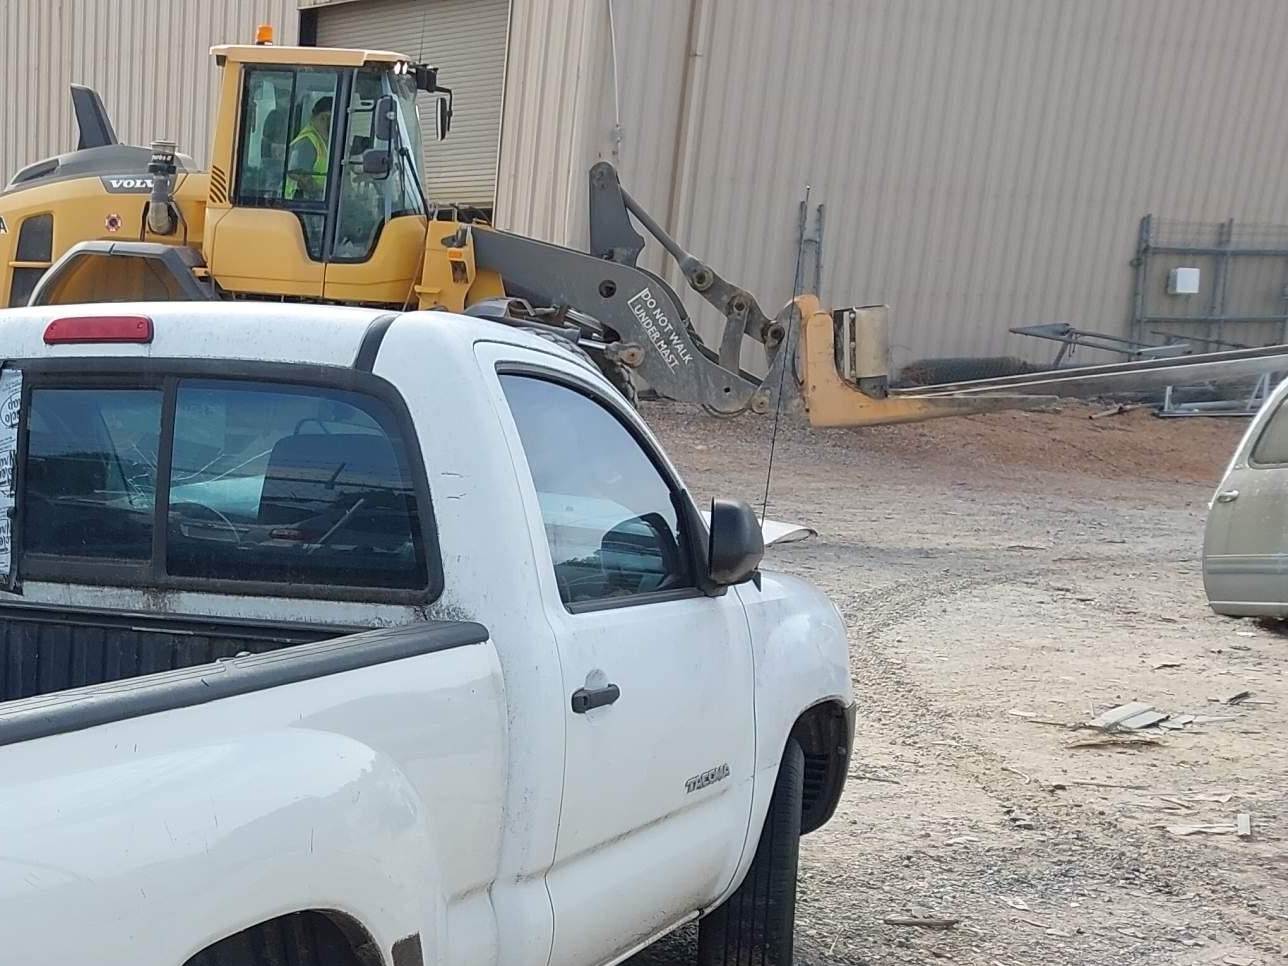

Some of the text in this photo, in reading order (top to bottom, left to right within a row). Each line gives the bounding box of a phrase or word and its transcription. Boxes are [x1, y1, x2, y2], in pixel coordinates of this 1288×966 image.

[110, 178, 170, 188] VOLV
[634, 304, 679, 366] UNDER MAST
[641, 290, 693, 365] DO NOT WALK
[685, 763, 730, 794] TACOMA
